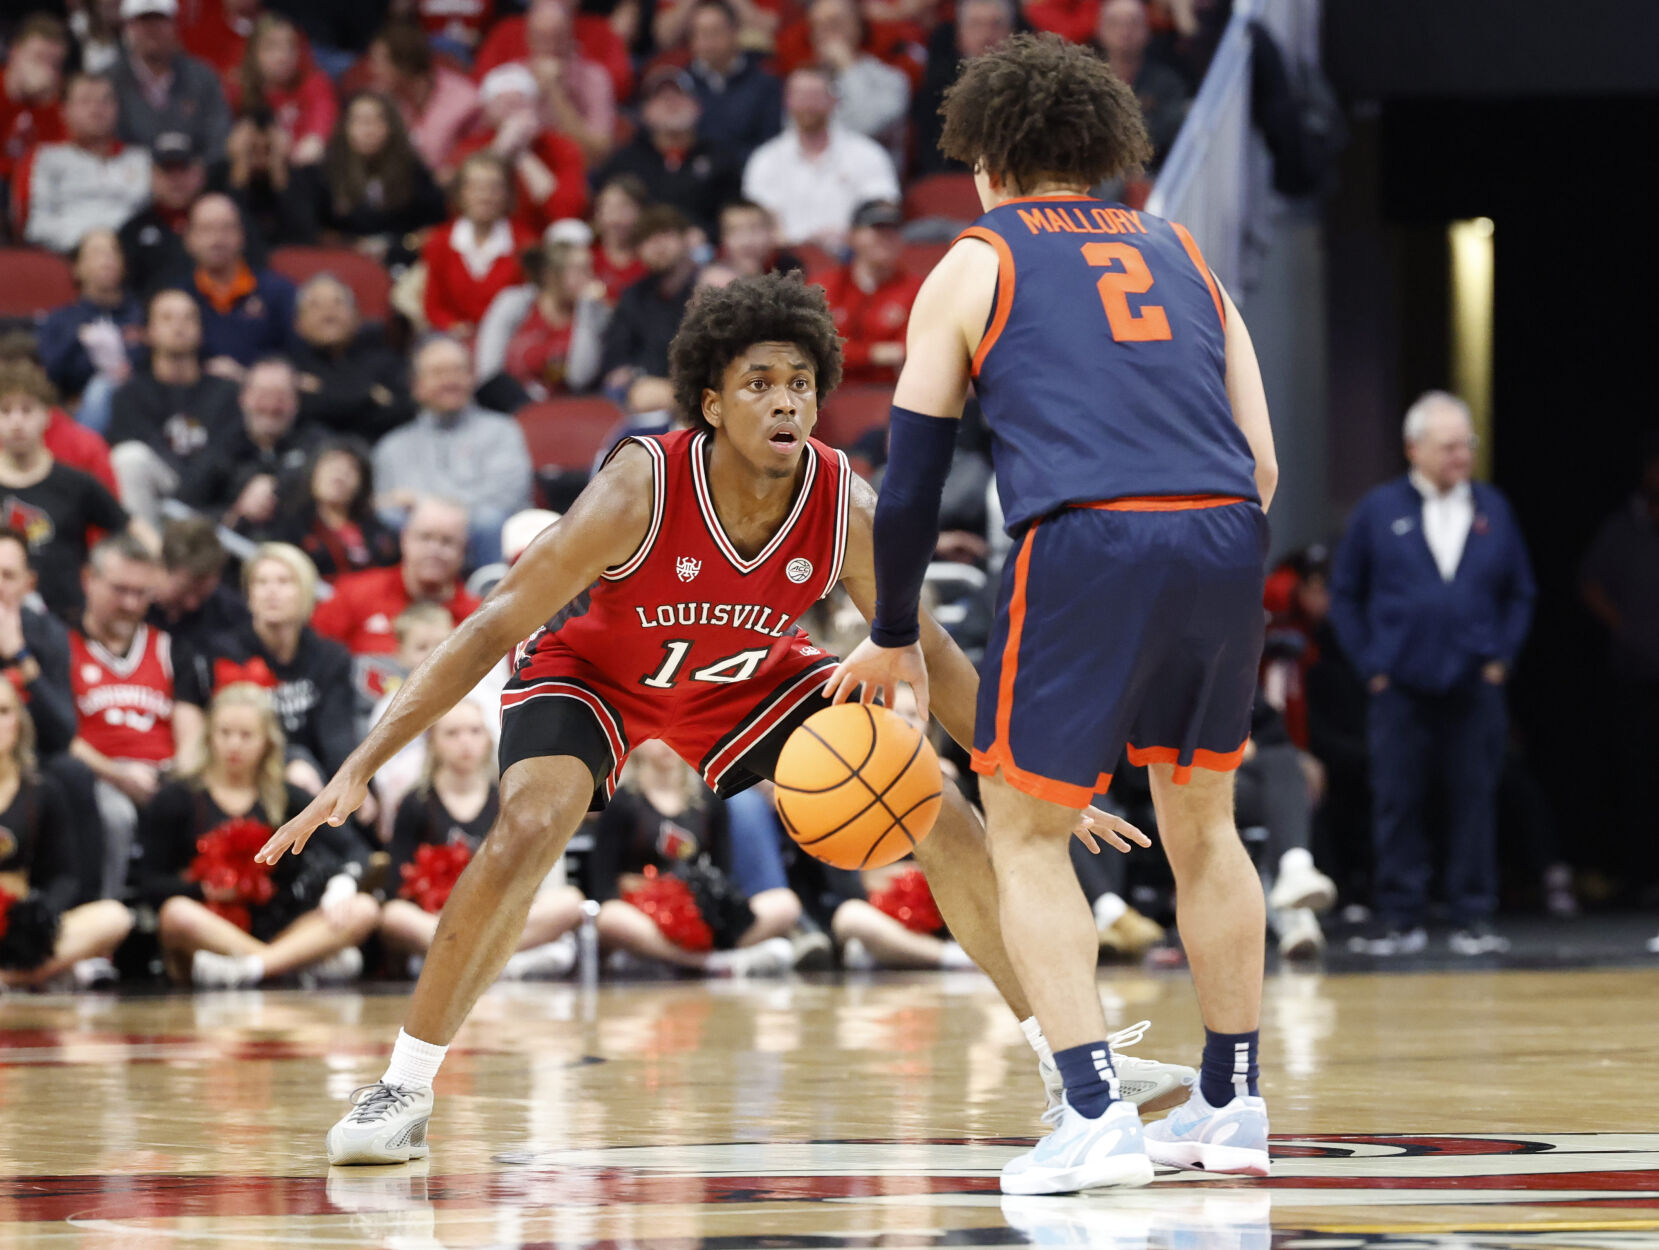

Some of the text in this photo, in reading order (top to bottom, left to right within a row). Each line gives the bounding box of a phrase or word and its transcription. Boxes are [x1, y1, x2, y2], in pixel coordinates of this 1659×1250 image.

[1017, 208, 1148, 235] MALLORY
[1080, 242, 1173, 342] 2
[636, 603, 790, 637] LOUISVILL
[640, 640, 769, 688] 14
